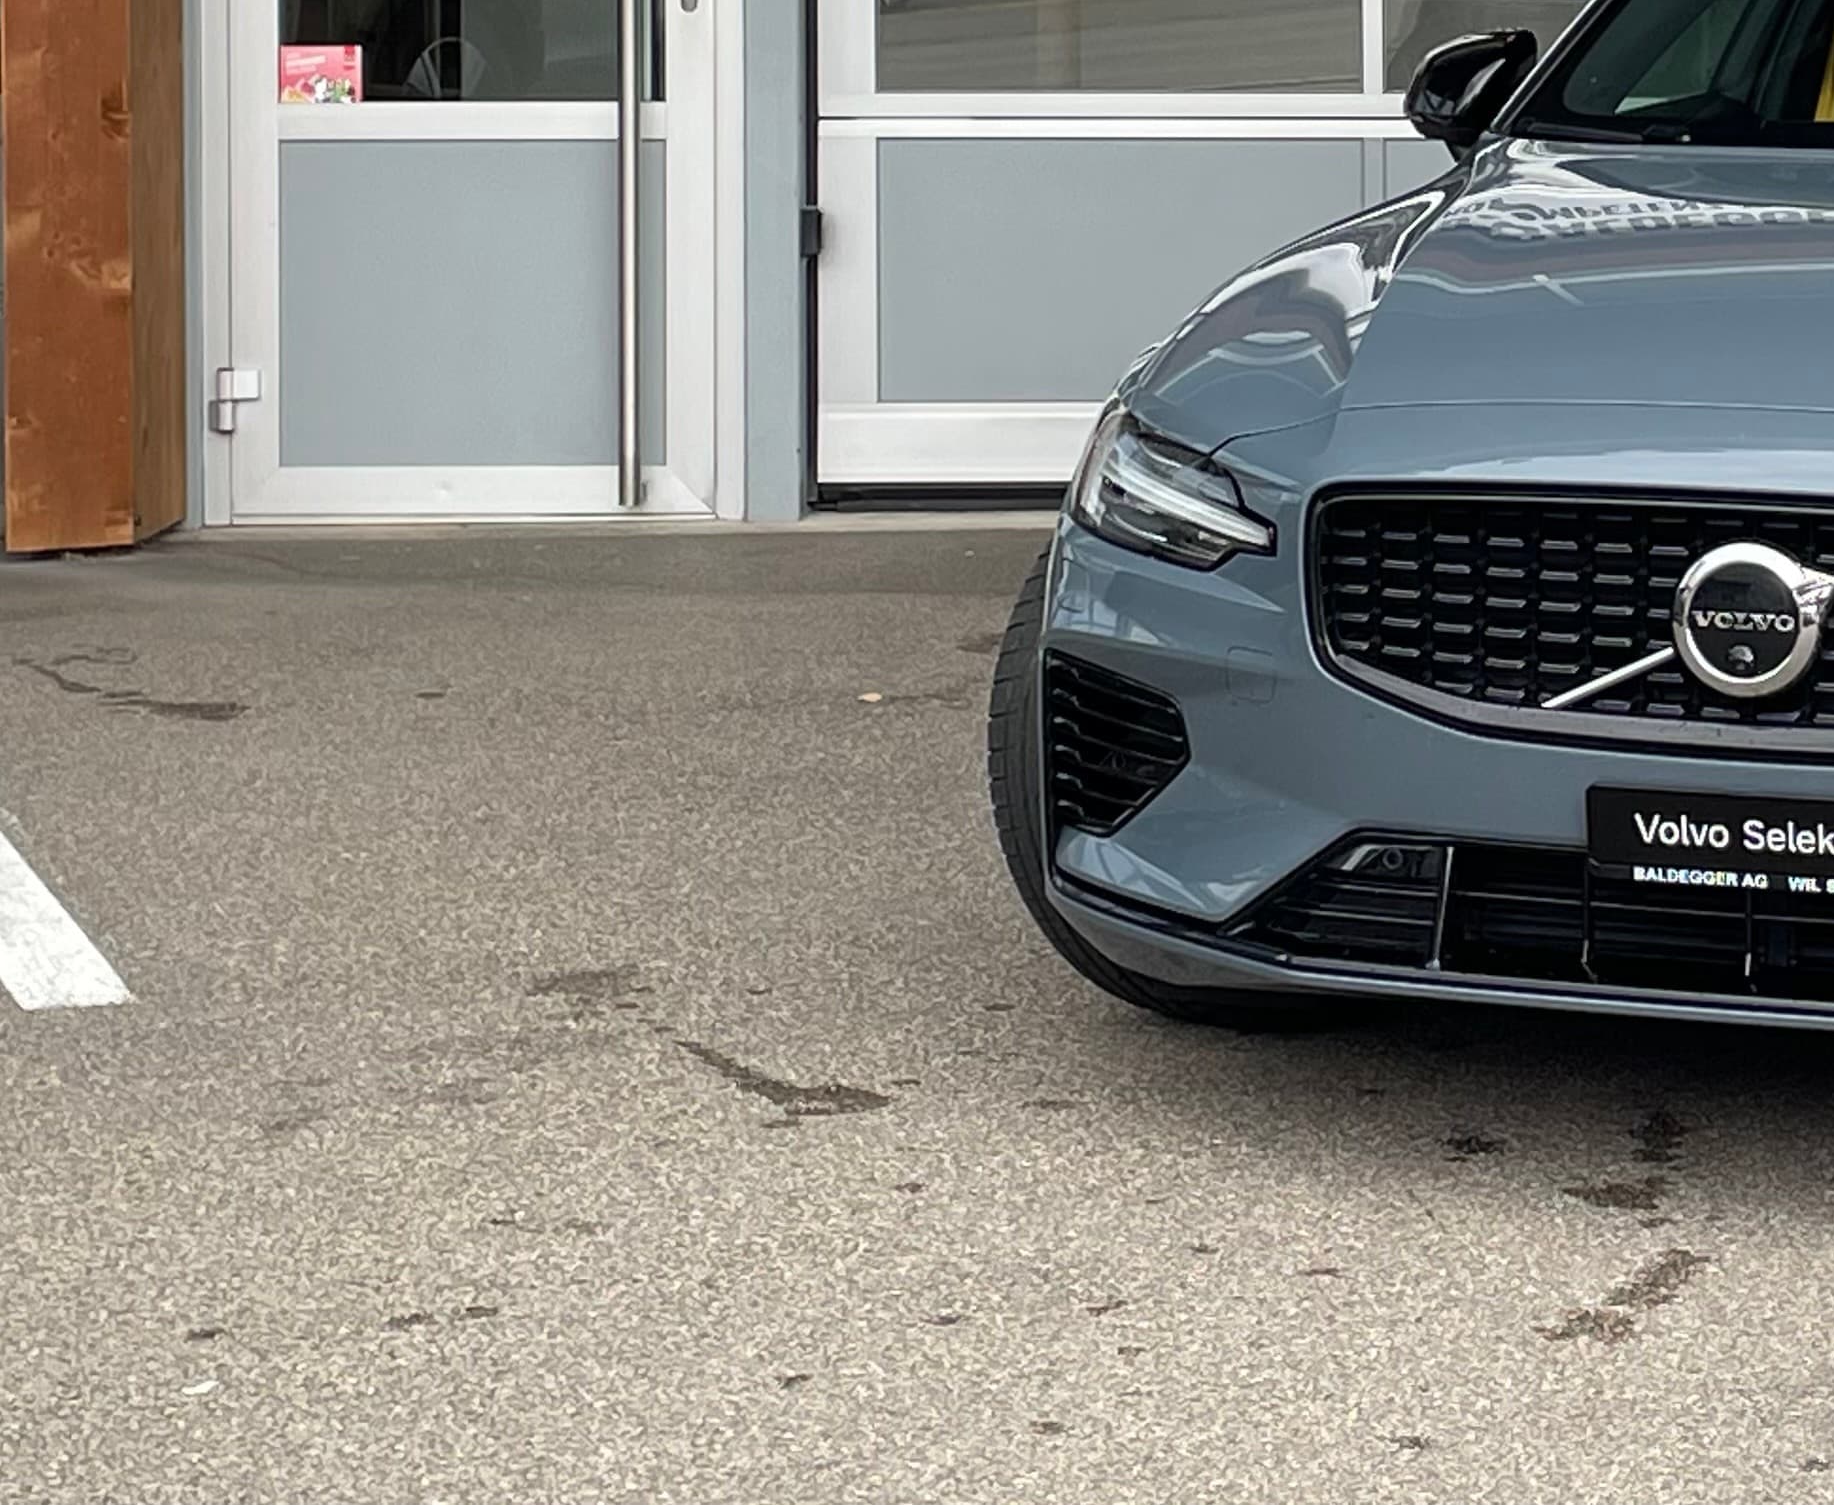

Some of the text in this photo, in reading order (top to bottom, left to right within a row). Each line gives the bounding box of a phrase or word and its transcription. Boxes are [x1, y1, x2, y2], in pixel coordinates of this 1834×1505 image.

[1691, 610, 1796, 632] VOLVO
[1633, 812, 1730, 848] Volvo
[1632, 866, 1738, 887] BALDEGGER
[1741, 873, 1769, 890] AG
